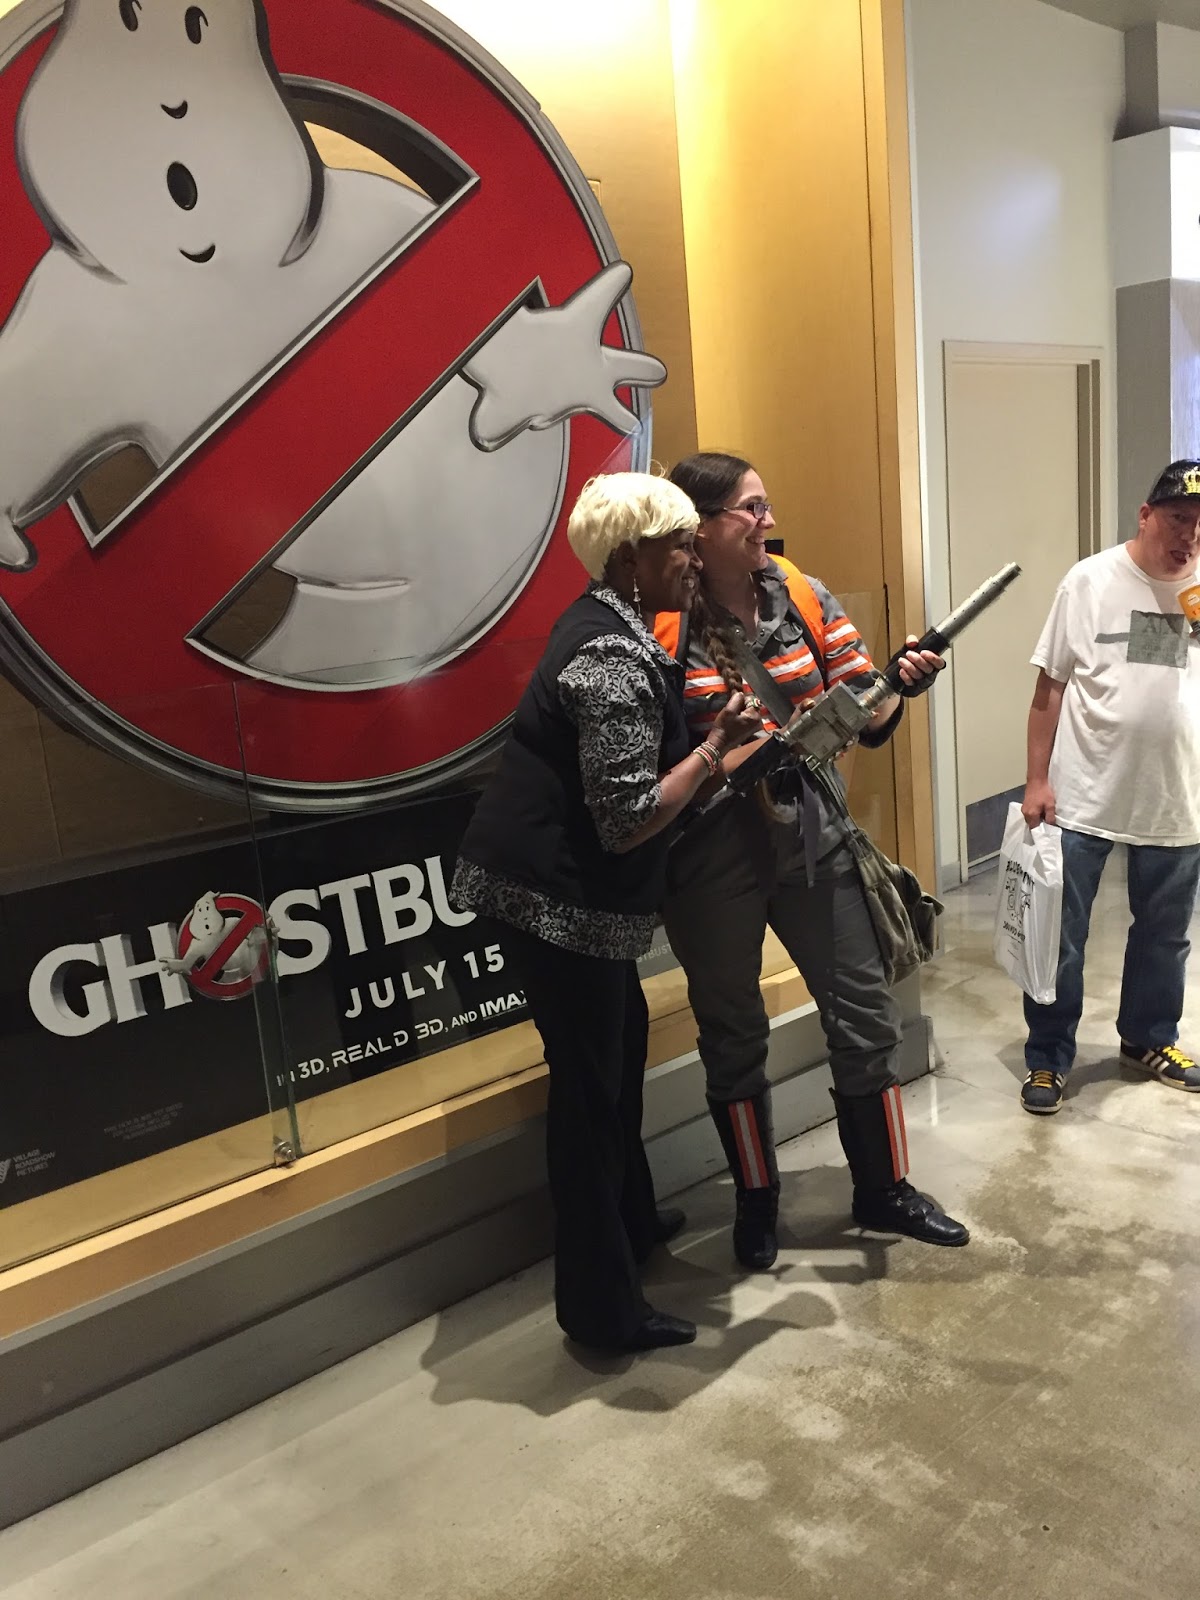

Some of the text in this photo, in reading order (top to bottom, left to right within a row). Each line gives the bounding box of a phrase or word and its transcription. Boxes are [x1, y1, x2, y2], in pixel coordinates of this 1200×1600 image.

[344, 944, 505, 1019] JULY 15
[297, 1058, 330, 1079] 3D,
[414, 1018, 449, 1040] 3D,
[451, 1011, 478, 1028] AND
[15, 1151, 56, 1170] ROADSHOW
